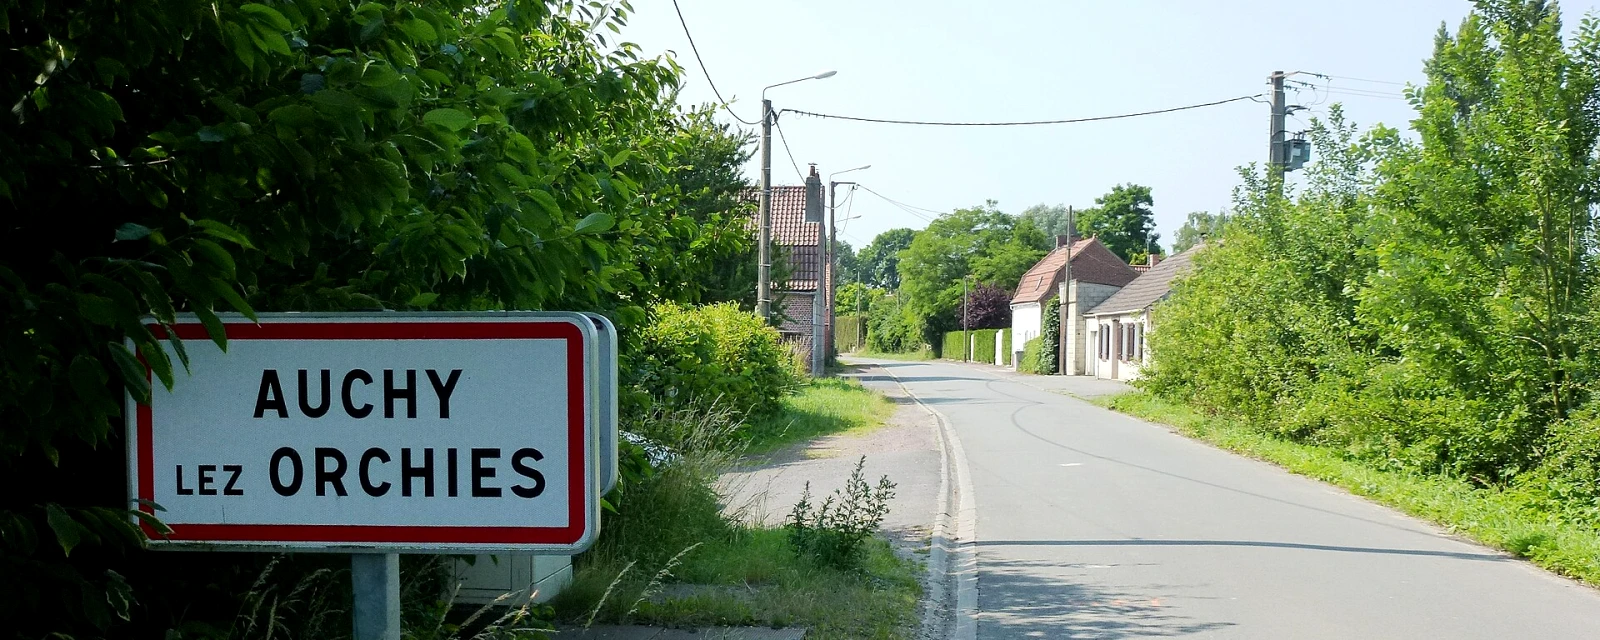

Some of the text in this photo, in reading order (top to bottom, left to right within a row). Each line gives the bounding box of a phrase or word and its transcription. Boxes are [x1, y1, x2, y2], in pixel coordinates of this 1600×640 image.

[253, 369, 463, 419] AUCHY
[176, 447, 546, 498] LEZ ORCHIES
